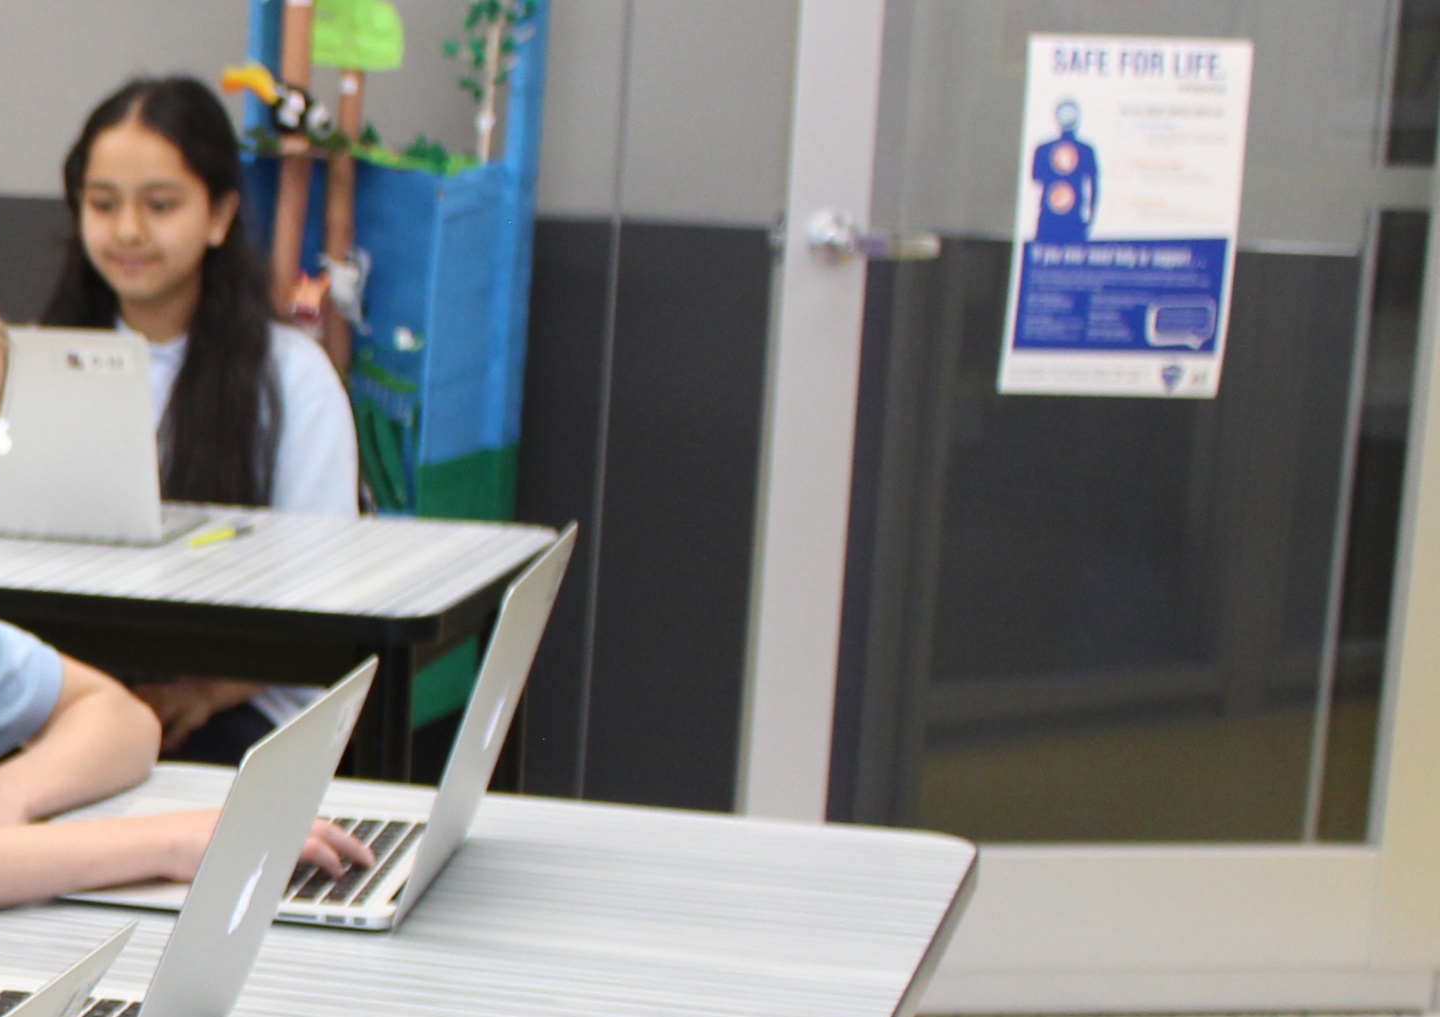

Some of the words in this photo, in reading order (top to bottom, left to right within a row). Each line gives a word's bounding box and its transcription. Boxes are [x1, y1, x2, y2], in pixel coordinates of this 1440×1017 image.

[1054, 47, 1108, 75] SAFE
[1120, 49, 1165, 77] FOR
[1173, 51, 1227, 81] LIFE.
